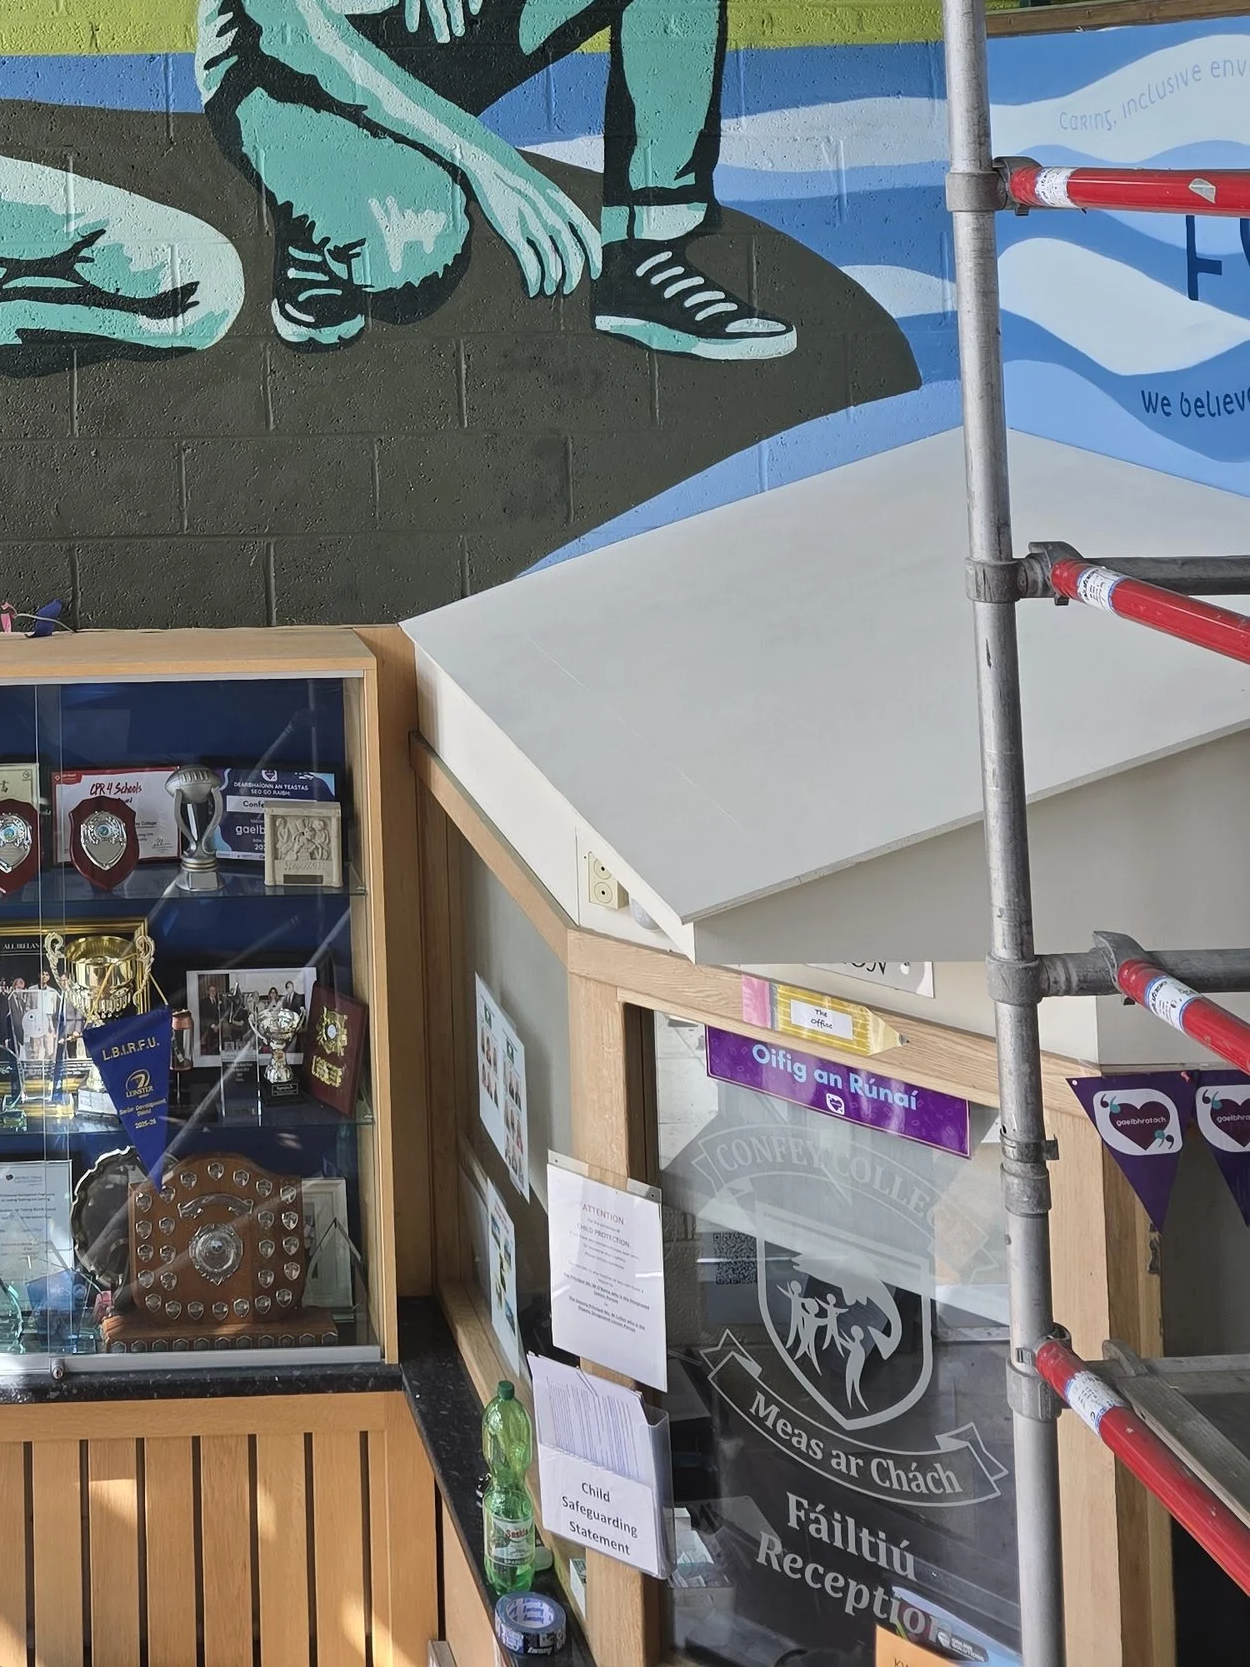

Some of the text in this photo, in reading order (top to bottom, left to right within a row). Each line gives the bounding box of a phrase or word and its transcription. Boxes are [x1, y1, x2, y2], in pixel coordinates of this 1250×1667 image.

[1141, 387, 1250, 418] We believ
[90, 782, 142, 795] CPR 4 Schools
[814, 1008, 828, 1018] The
[102, 1036, 161, 1061] L.B.I.R.F.U.
[125, 1085, 153, 1098] LEINSTER
[752, 1043, 919, 1111] Oifig an Rúnaí
[1116, 1116, 1167, 1127] gaelbhratach
[715, 1134, 825, 1171] CONFEY
[582, 1203, 624, 1226] ATTENTION
[749, 1390, 963, 1495] Meas ar Chách
[581, 1482, 611, 1503] Child
[561, 1496, 638, 1539] Safeguarding
[569, 1520, 630, 1556] Statement
[786, 1491, 918, 1582] Fáiltiú
[755, 1530, 953, 1643] Reception
